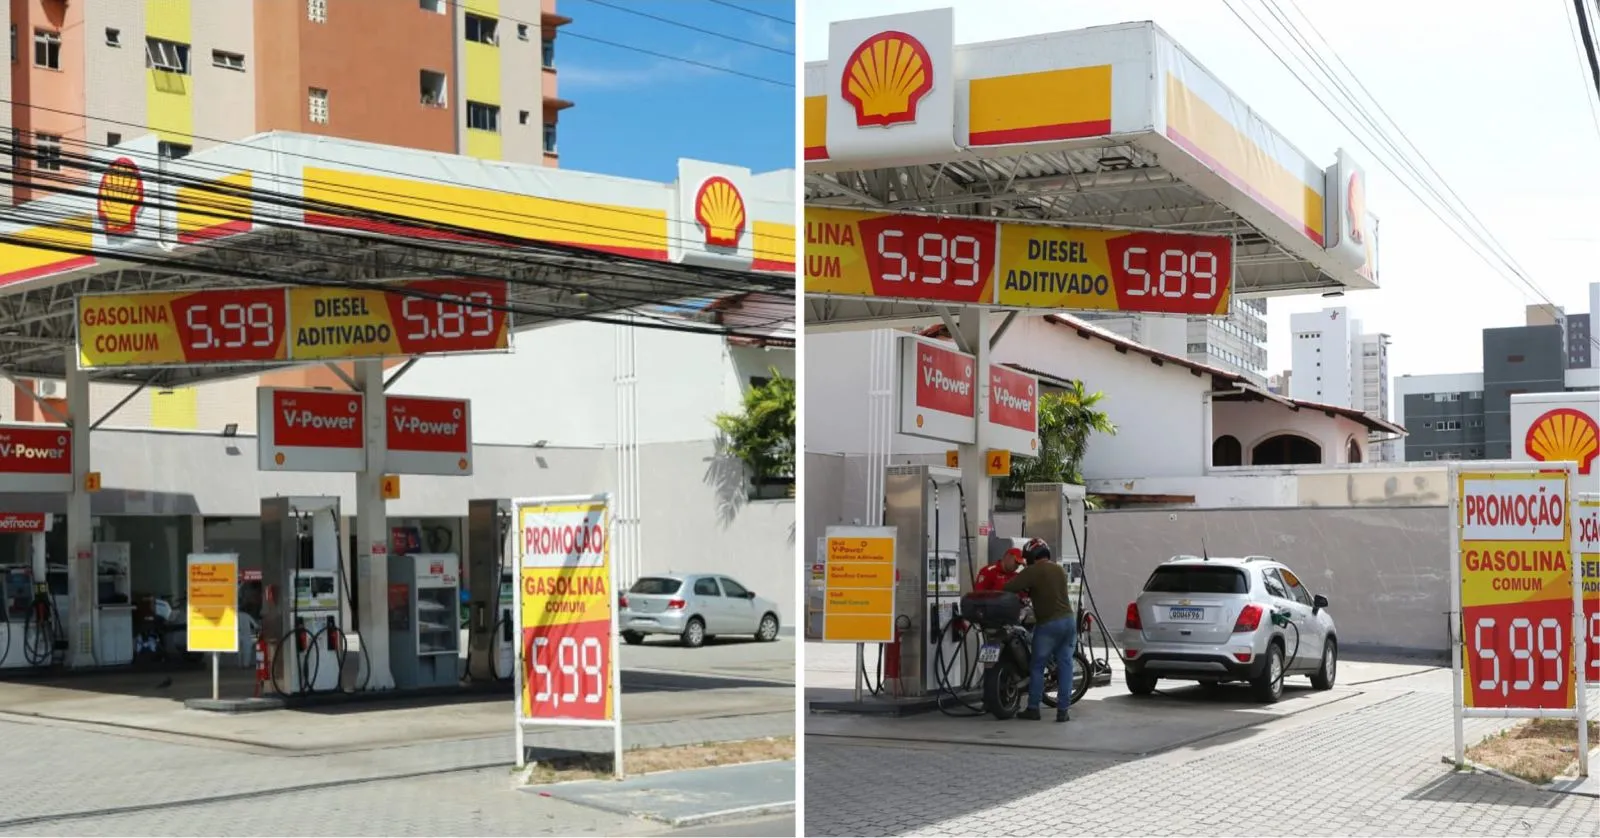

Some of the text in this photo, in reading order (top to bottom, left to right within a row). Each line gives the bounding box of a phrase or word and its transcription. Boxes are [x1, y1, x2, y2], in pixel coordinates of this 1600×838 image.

[804, 222, 855, 246] LINA
[804, 255, 841, 278] UM
[1028, 239, 1217, 299] DIESEL 5.89
[1004, 270, 1109, 296] ADITIVADO
[83, 305, 168, 326] GASOLINA
[314, 297, 369, 318] DIESEL
[95, 333, 159, 353] COMUM
[297, 323, 391, 346] ADITIVADO
[923, 366, 970, 396] V-Power
[993, 385, 1031, 413] V-Power
[283, 409, 355, 430] V-Power
[394, 415, 459, 435] V-Power
[992, 455, 1002, 470] 4
[384, 480, 393, 494] 4
[1465, 486, 1562, 534] PROMOÇÃO
[526, 518, 602, 560] PROMOÇÃO
[1465, 550, 1566, 571] GASOLINA
[525, 575, 605, 596] GASOLINA
[1492, 578, 1542, 591] COMUM
[545, 600, 586, 613] COMUM
[1475, 618, 1562, 697] 5,99
[532, 637, 602, 708] 5,99
